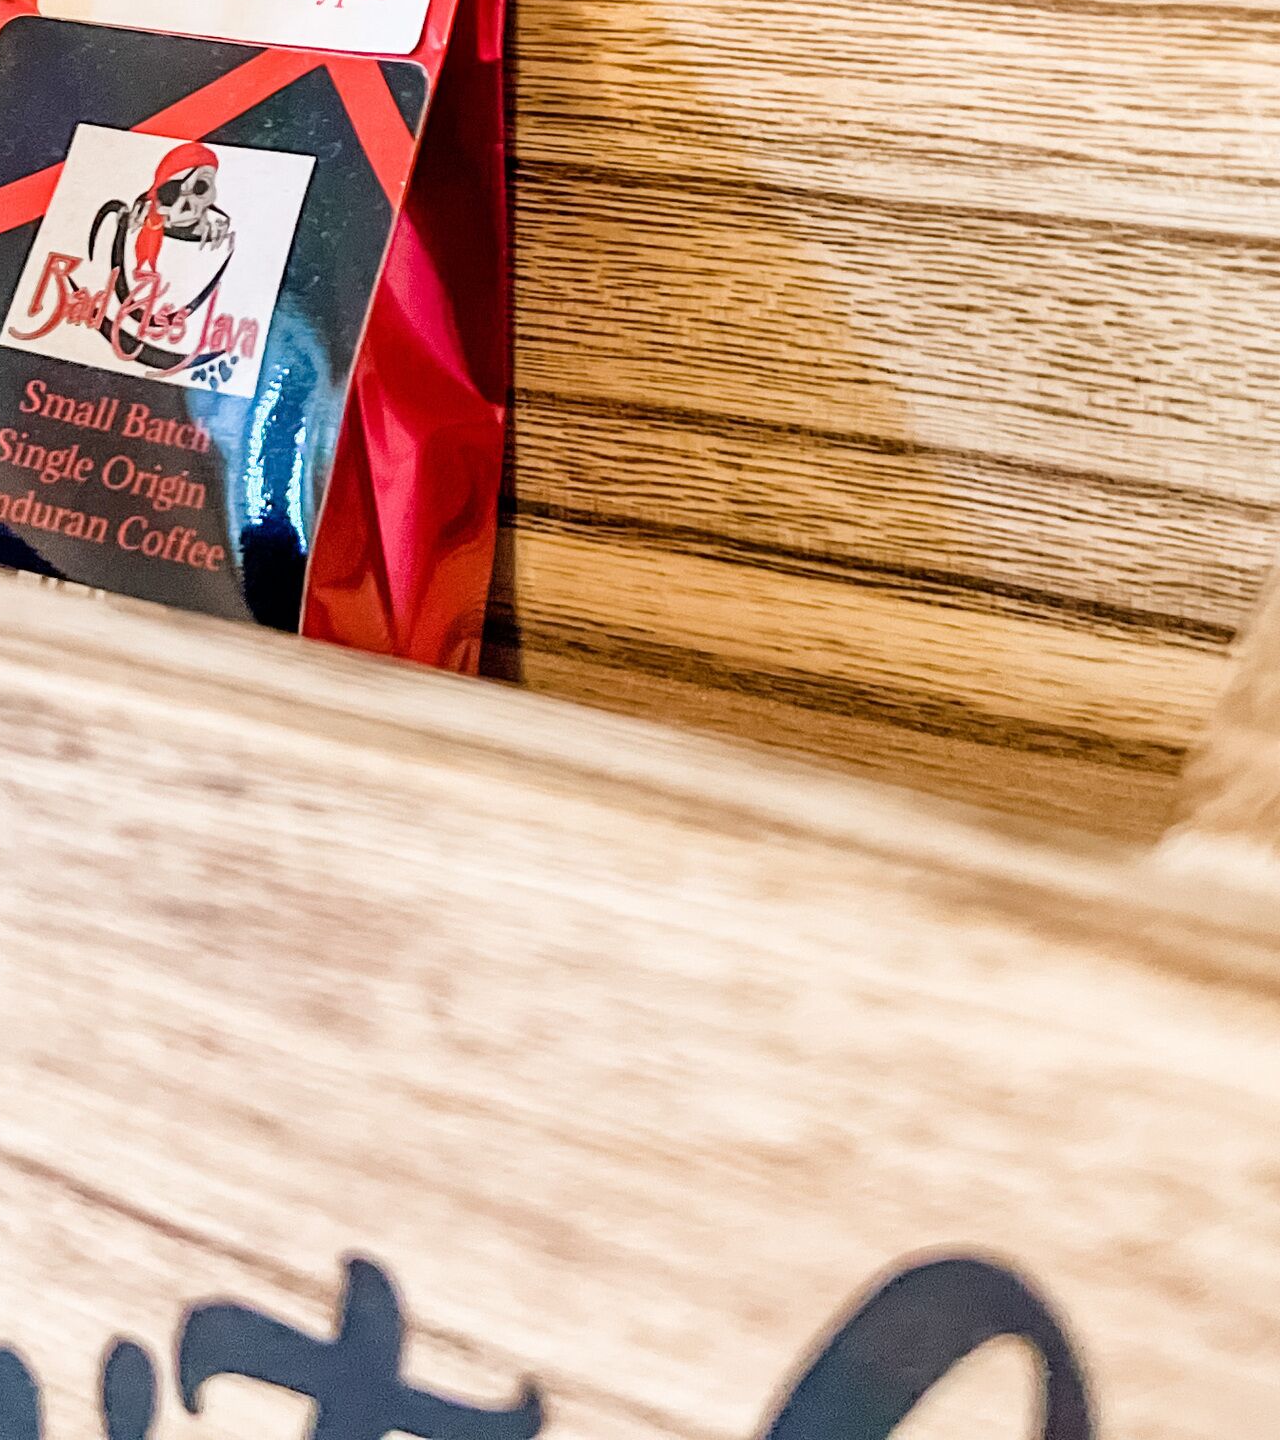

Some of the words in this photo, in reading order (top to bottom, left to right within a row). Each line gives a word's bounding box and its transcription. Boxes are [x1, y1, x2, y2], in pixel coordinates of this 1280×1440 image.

[8, 251, 120, 341] Bad
[111, 269, 191, 361] Ass
[145, 282, 261, 378] Java
[19, 379, 119, 437] Small
[121, 402, 212, 455] Batch
[101, 453, 206, 512] Origin
[116, 513, 226, 574] Coffee
